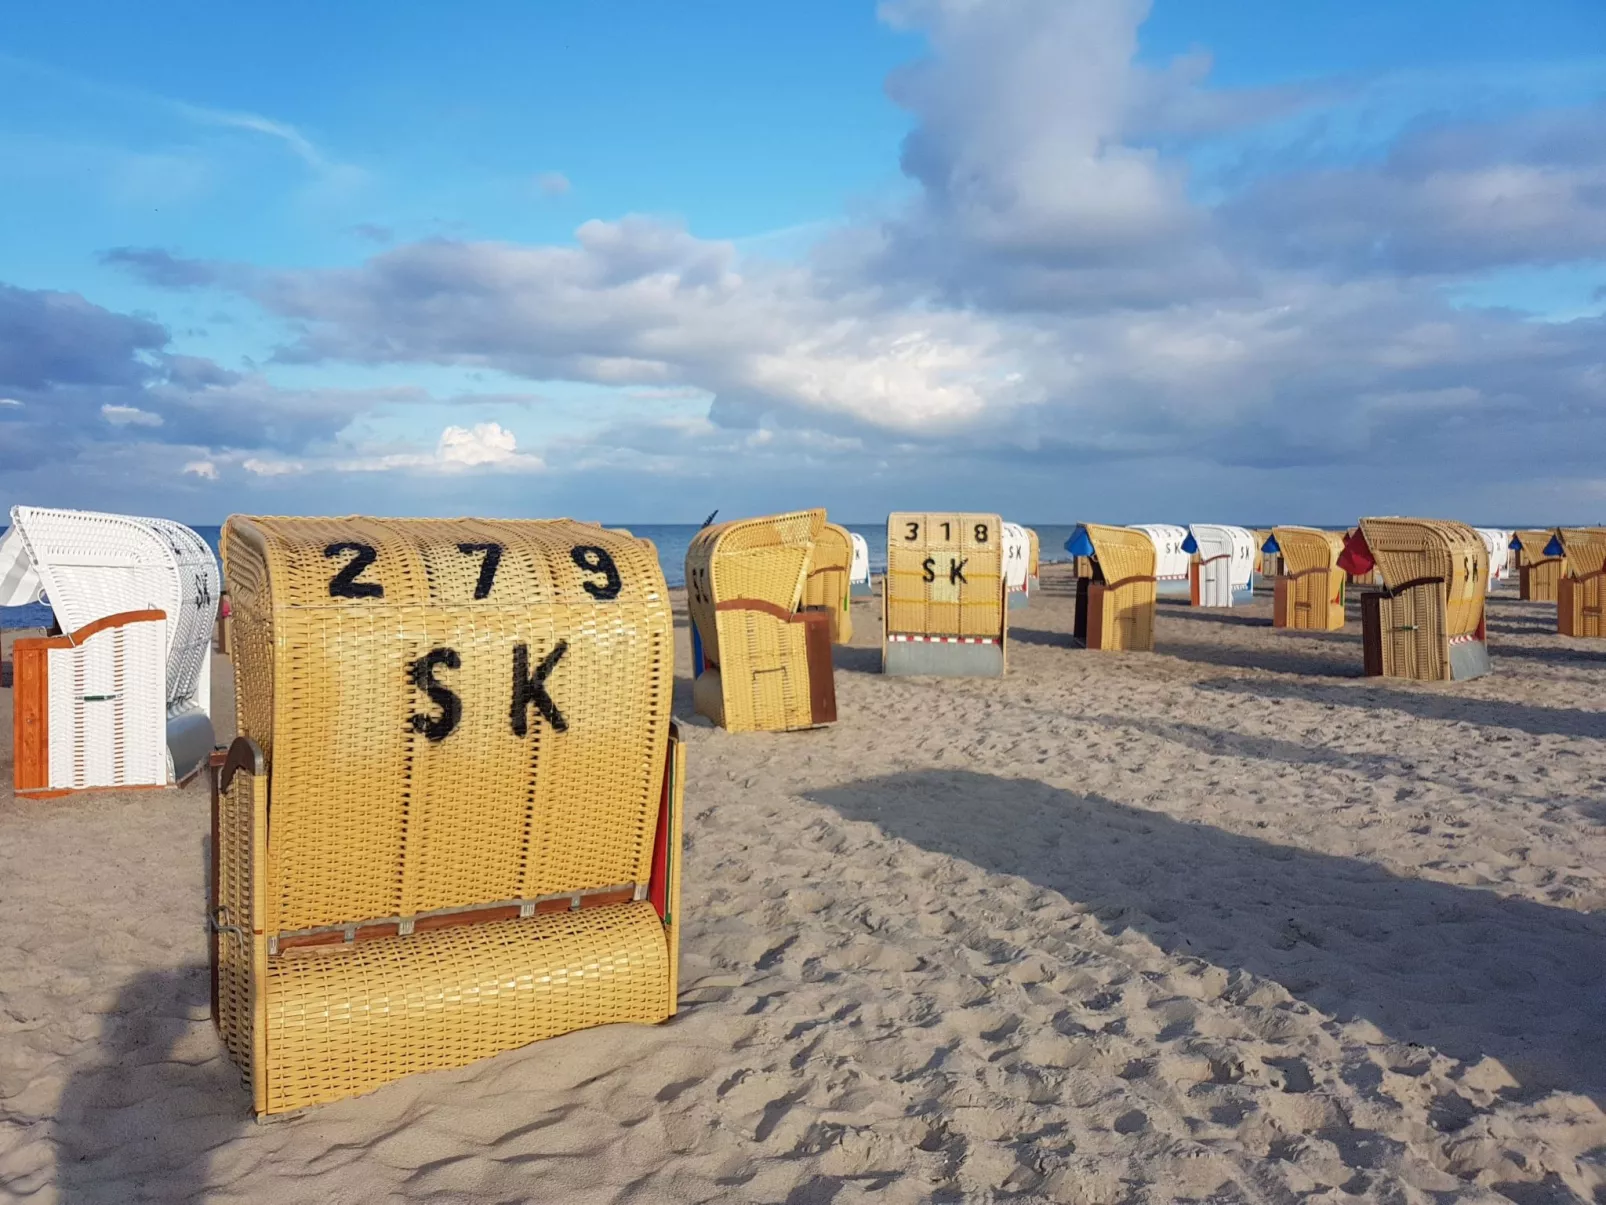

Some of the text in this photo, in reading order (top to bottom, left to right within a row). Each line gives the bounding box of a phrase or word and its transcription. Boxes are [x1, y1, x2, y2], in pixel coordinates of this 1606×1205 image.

[904, 522, 988, 543] 318
[1008, 544, 1022, 561] SK
[1166, 541, 1181, 555] SK
[1240, 545, 1250, 561] SK
[324, 542, 622, 600] 279
[922, 556, 969, 586] SK
[1463, 555, 1479, 583] SK
[408, 639, 570, 743] SK
